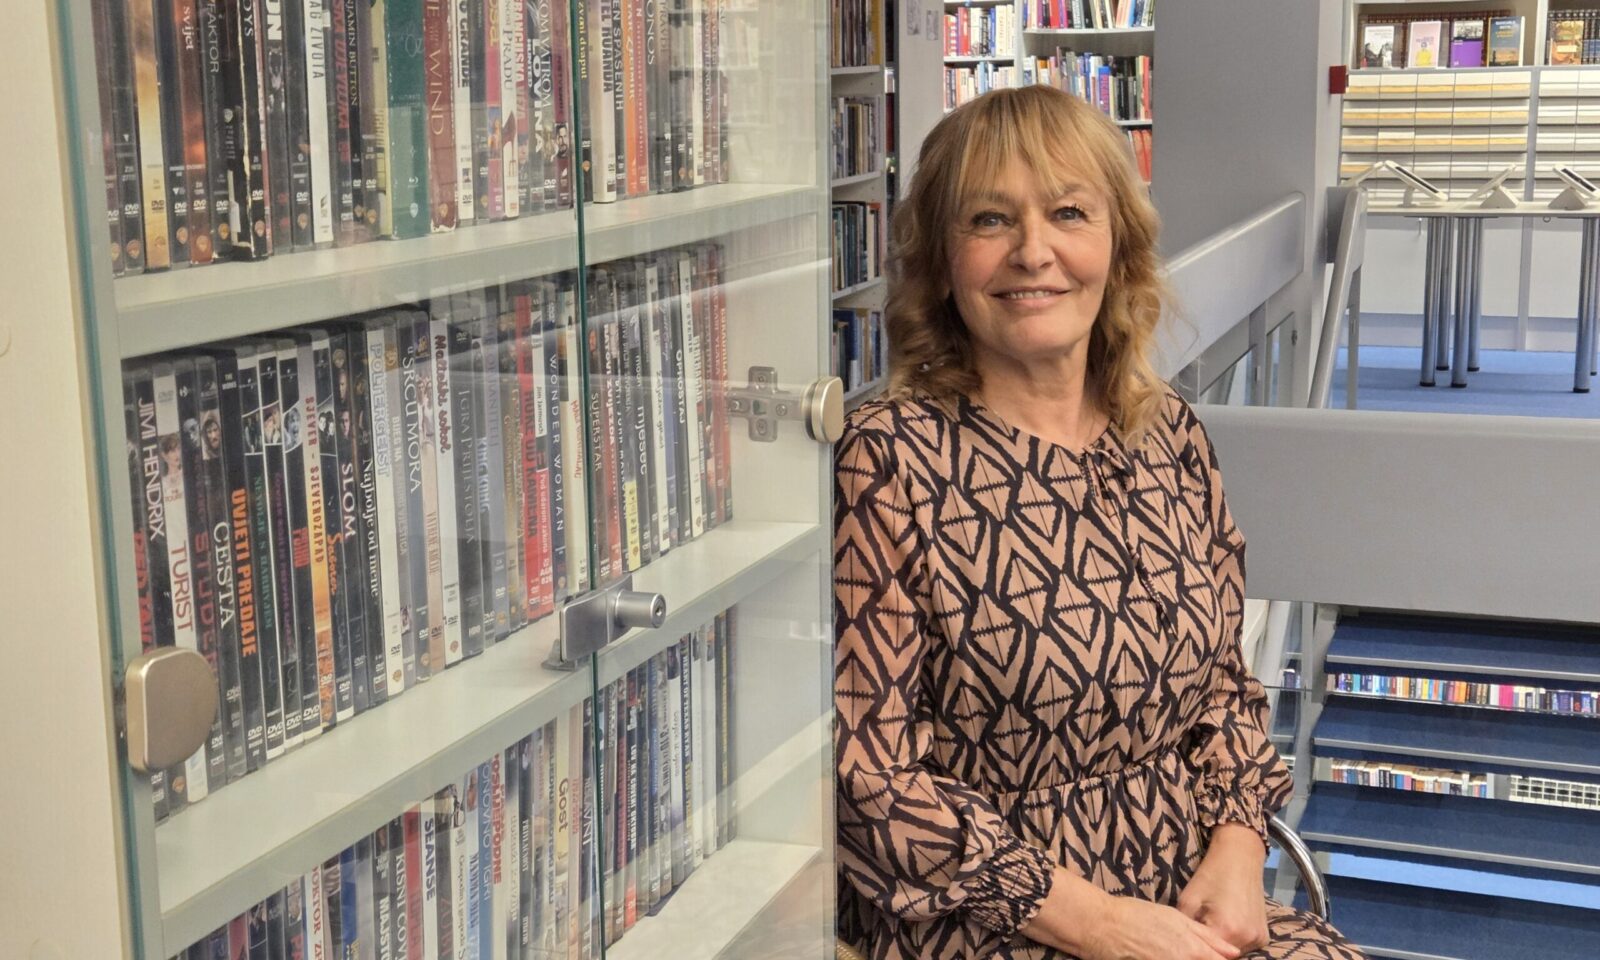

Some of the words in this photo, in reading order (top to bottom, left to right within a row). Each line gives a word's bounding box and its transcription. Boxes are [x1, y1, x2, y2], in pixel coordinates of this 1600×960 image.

[182, 6, 194, 50] svijet
[208, 4, 220, 73] FAKTOR
[460, 18, 470, 88] GRANDE
[504, 29, 514, 91] PRADU
[602, 27, 614, 92] RUANDA
[348, 50, 358, 106] BUTTON
[429, 49, 444, 136] WIND
[532, 39, 544, 153] LOVINA
[541, 37, 552, 108] VATROM
[614, 27, 624, 111] SPASENIH
[138, 398, 157, 440] JIMI
[304, 396, 318, 446] SJEVER
[370, 344, 392, 476] POLTERGEIST
[402, 357, 418, 416] SRCU
[458, 390, 471, 432] IGRA
[550, 354, 560, 444] WONDER
[606, 380, 615, 446] ZVIJEZDA
[406, 423, 422, 494] MORA
[438, 410, 452, 454] sokol
[476, 436, 488, 470] KING
[591, 392, 602, 472] SUPERSTAR
[636, 406, 648, 475] mjesec
[143, 446, 165, 541] HENDRIX
[232, 488, 251, 561] UVJETI
[310, 466, 324, 563] SJEVEROZAPAD
[342, 463, 356, 539] SLOM
[360, 458, 376, 528] Najbolje
[553, 454, 564, 532] WOMAN
[366, 530, 378, 550] od
[172, 540, 193, 632] TURIST
[214, 522, 236, 628] CESTA
[368, 554, 380, 597] mene
[237, 565, 256, 658] PREDAJE
[248, 726, 262, 736] DVD
[268, 722, 284, 734] DVD
[287, 715, 301, 726] DVD
[304, 704, 319, 716] DVD
[558, 778, 569, 833] Gost
[424, 818, 436, 902] SEANSE
[484, 865, 492, 900] IGRI
